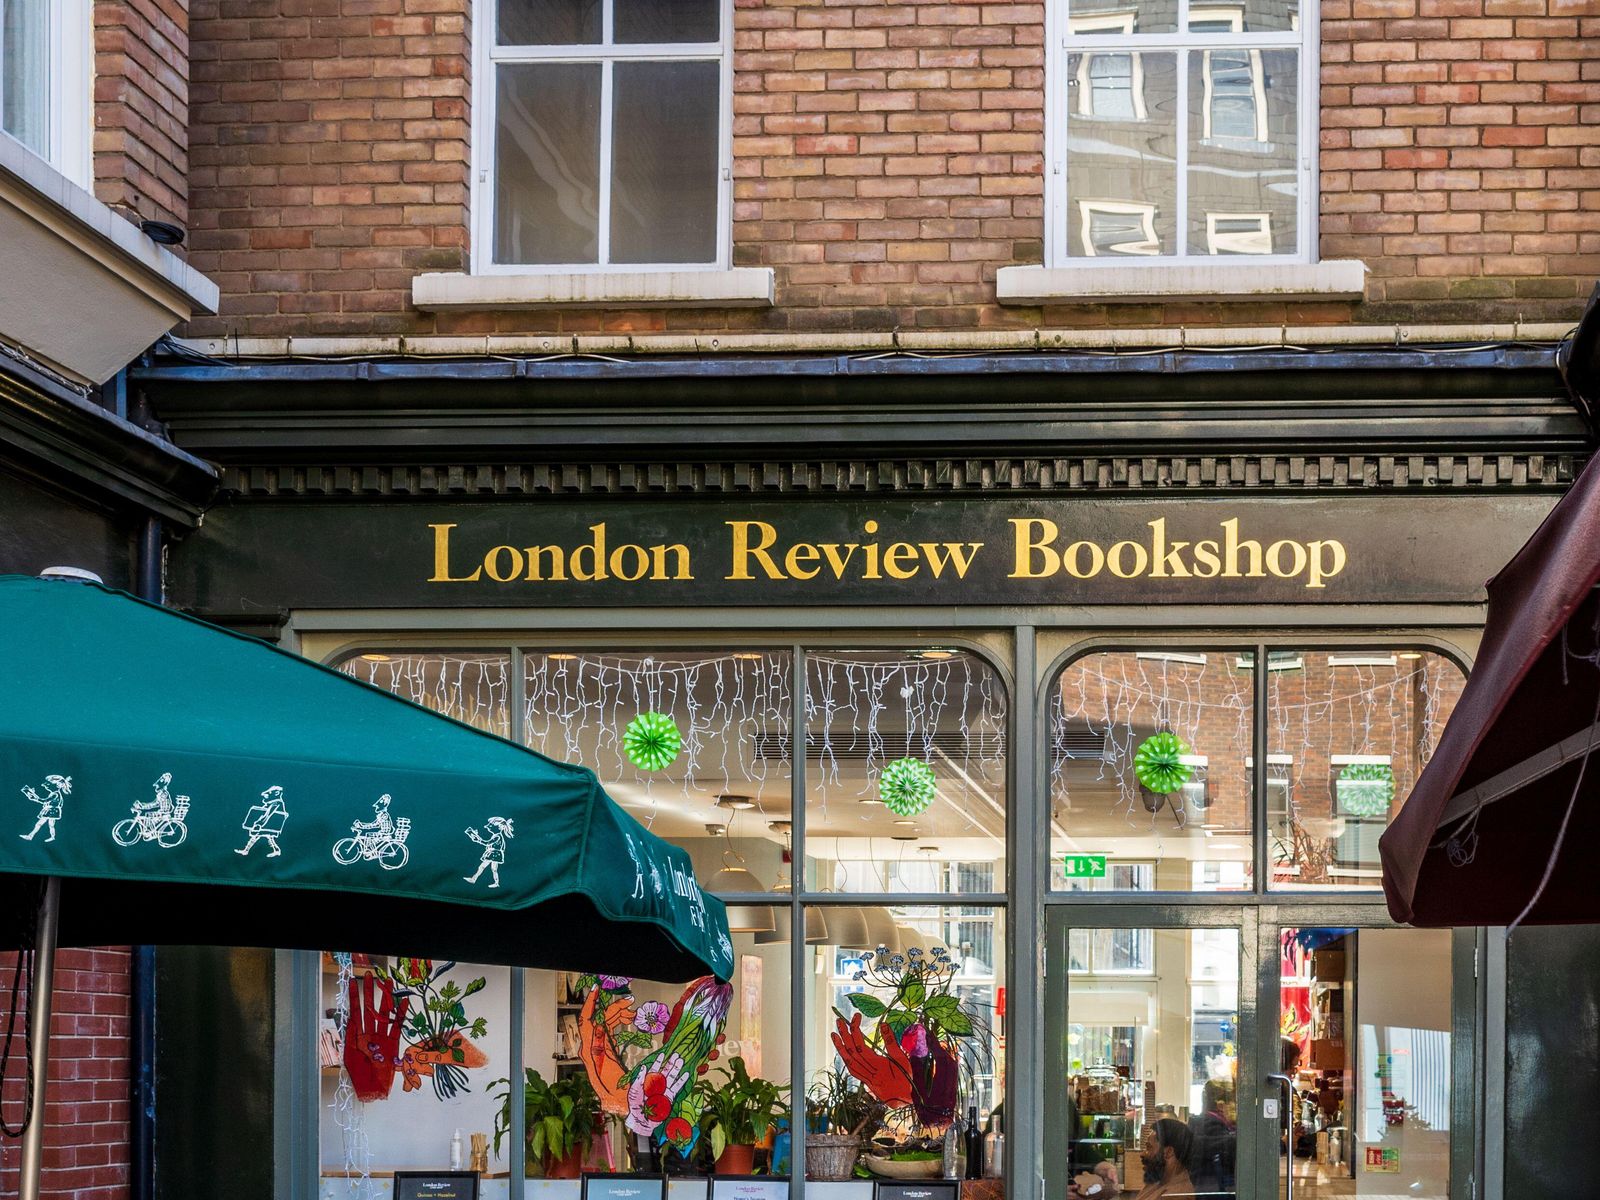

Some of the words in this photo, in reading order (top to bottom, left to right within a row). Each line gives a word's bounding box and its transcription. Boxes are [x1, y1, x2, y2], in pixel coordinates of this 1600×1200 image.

[427, 521, 694, 582] London
[724, 519, 984, 580] Review
[1007, 516, 1347, 588] Bookshop
